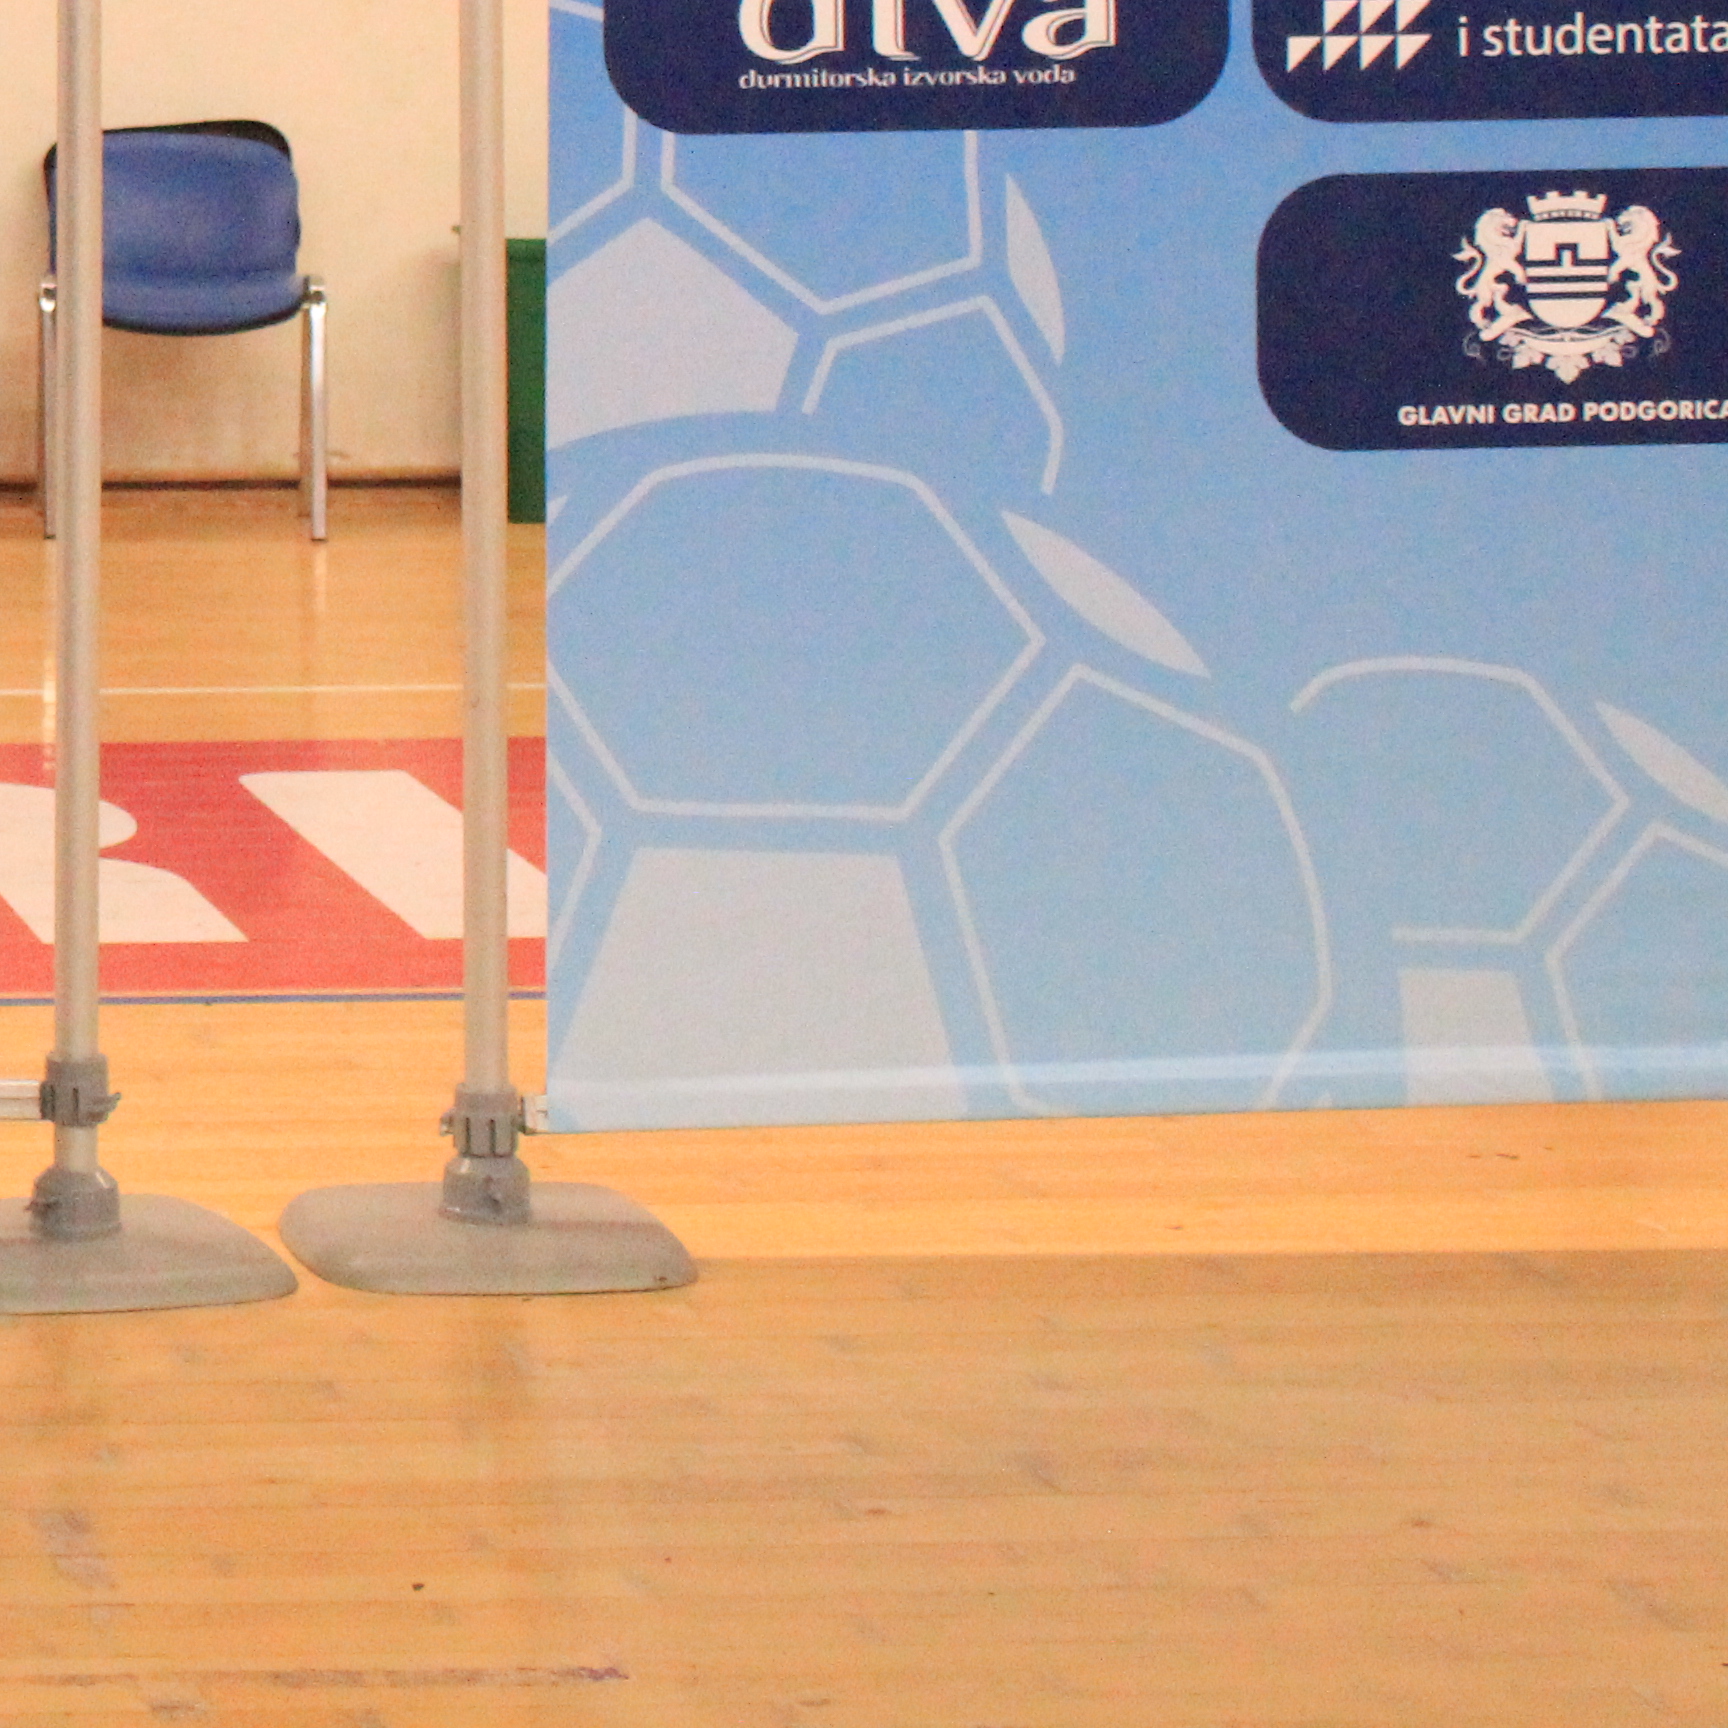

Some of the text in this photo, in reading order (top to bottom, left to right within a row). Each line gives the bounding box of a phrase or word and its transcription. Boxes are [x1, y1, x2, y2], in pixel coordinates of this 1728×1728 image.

[1458, 11, 1728, 59] i studentata
[738, 63, 1078, 91] durmitorska izvorska voda
[1397, 404, 1497, 428] GLAVNI
[1503, 402, 1578, 426] GRAD
